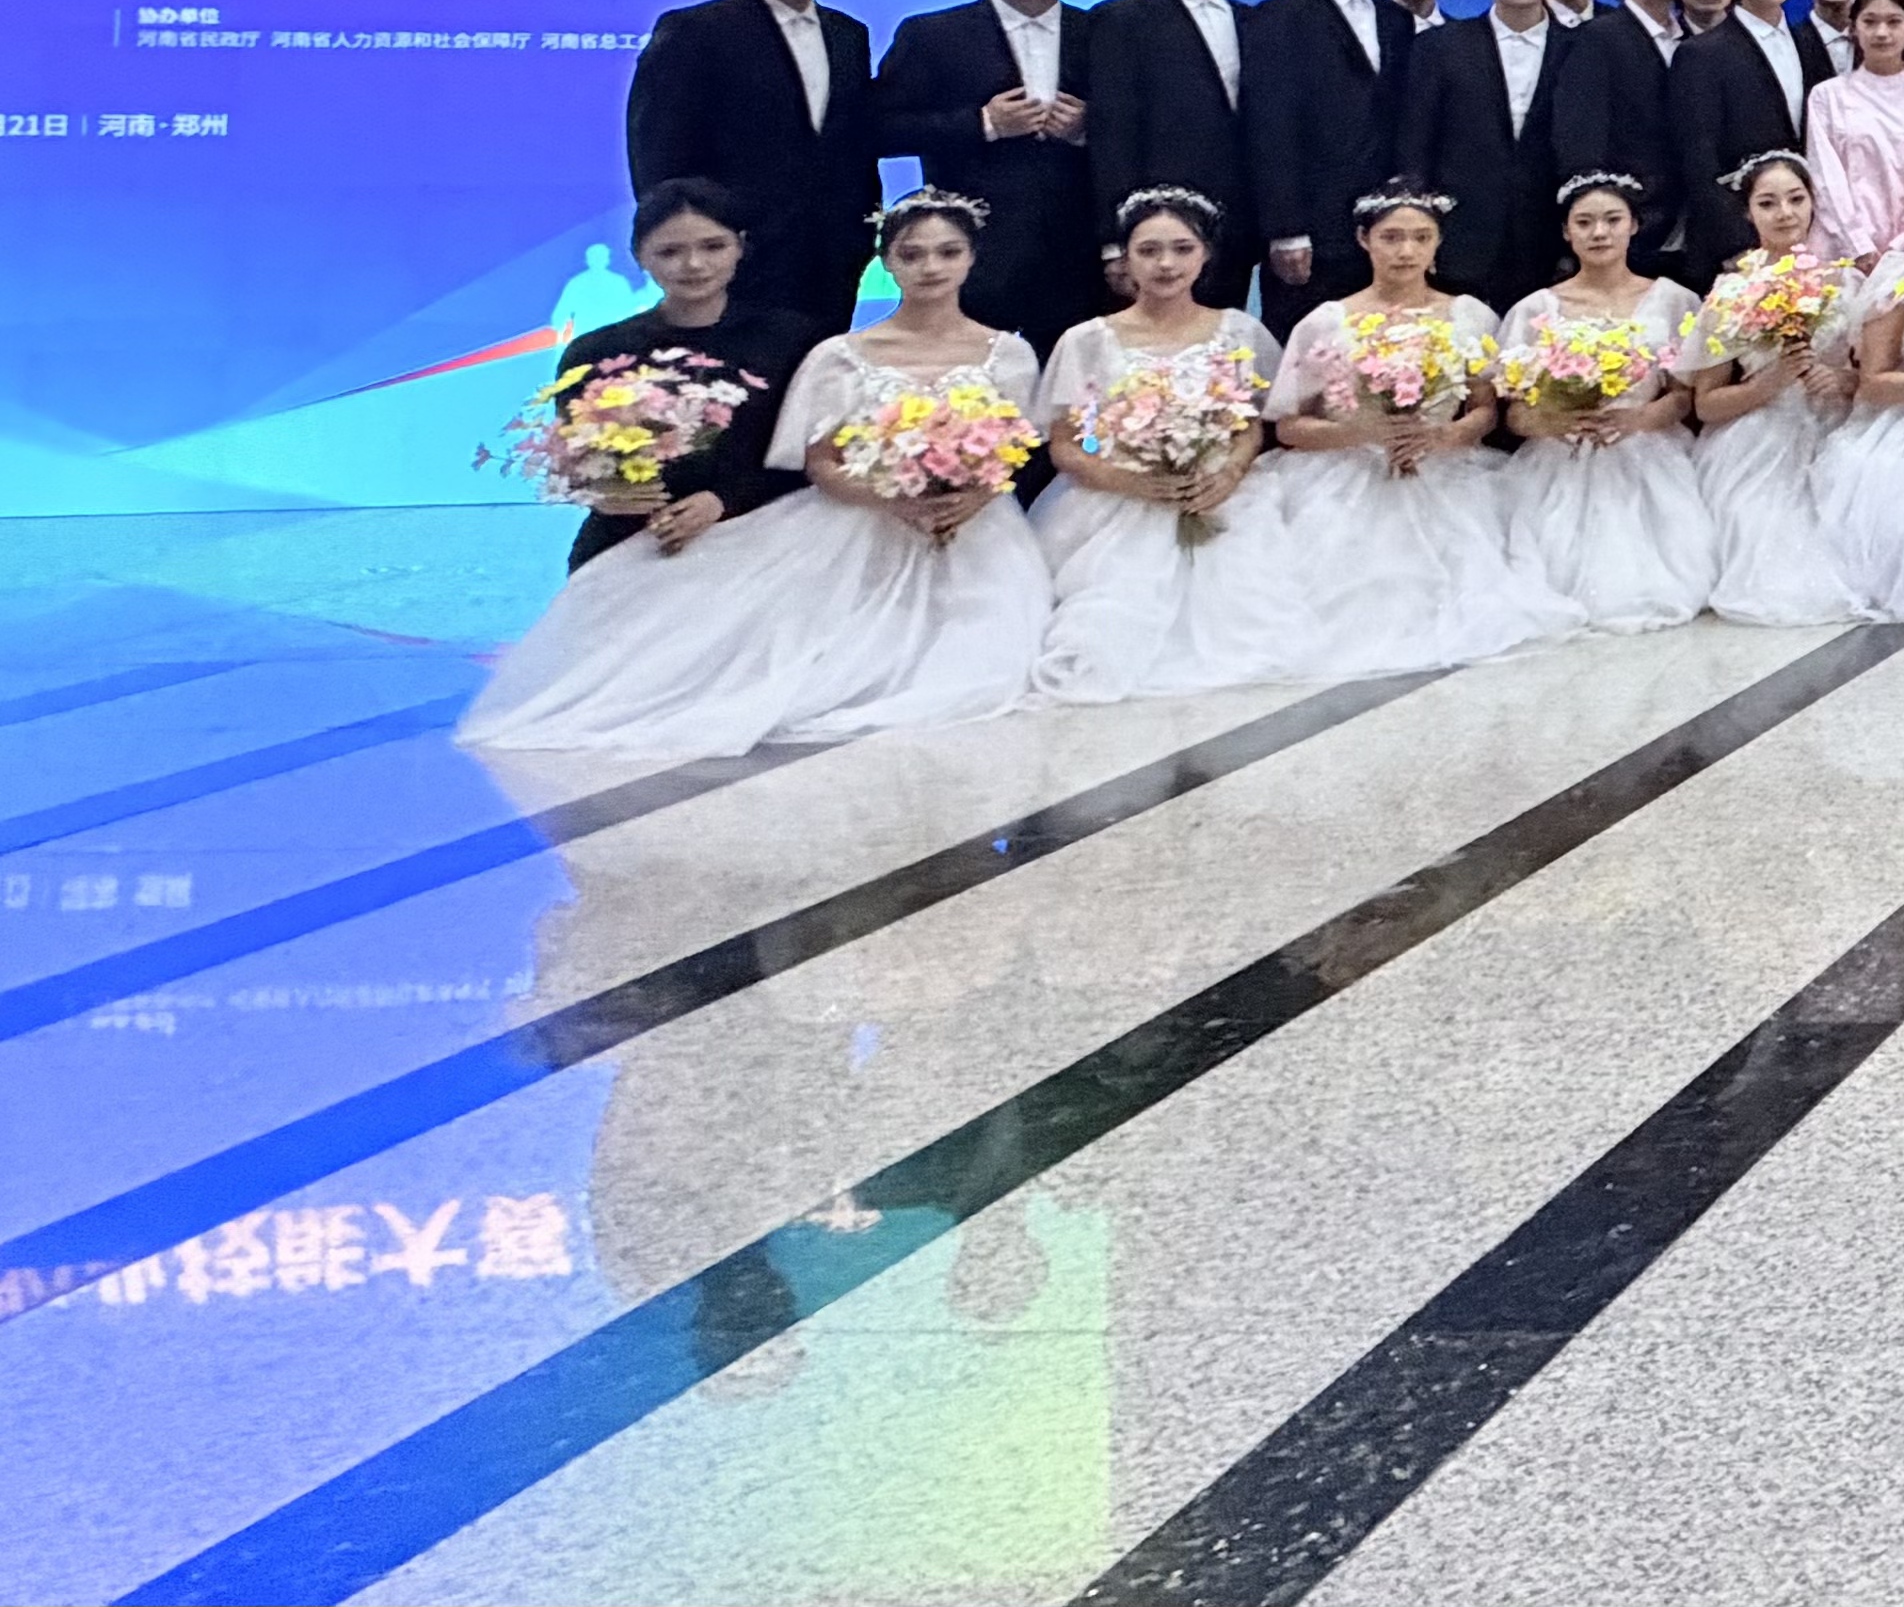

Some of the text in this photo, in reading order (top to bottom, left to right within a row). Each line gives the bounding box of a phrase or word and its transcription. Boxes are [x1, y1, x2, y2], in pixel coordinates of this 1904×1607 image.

[137, 7, 220, 25] 协办单位
[137, 31, 260, 48] 河南省民政厅
[270, 31, 531, 50] 河南省人力资源和社会保障厅
[0, 113, 229, 138] 21日 河南·郑州
